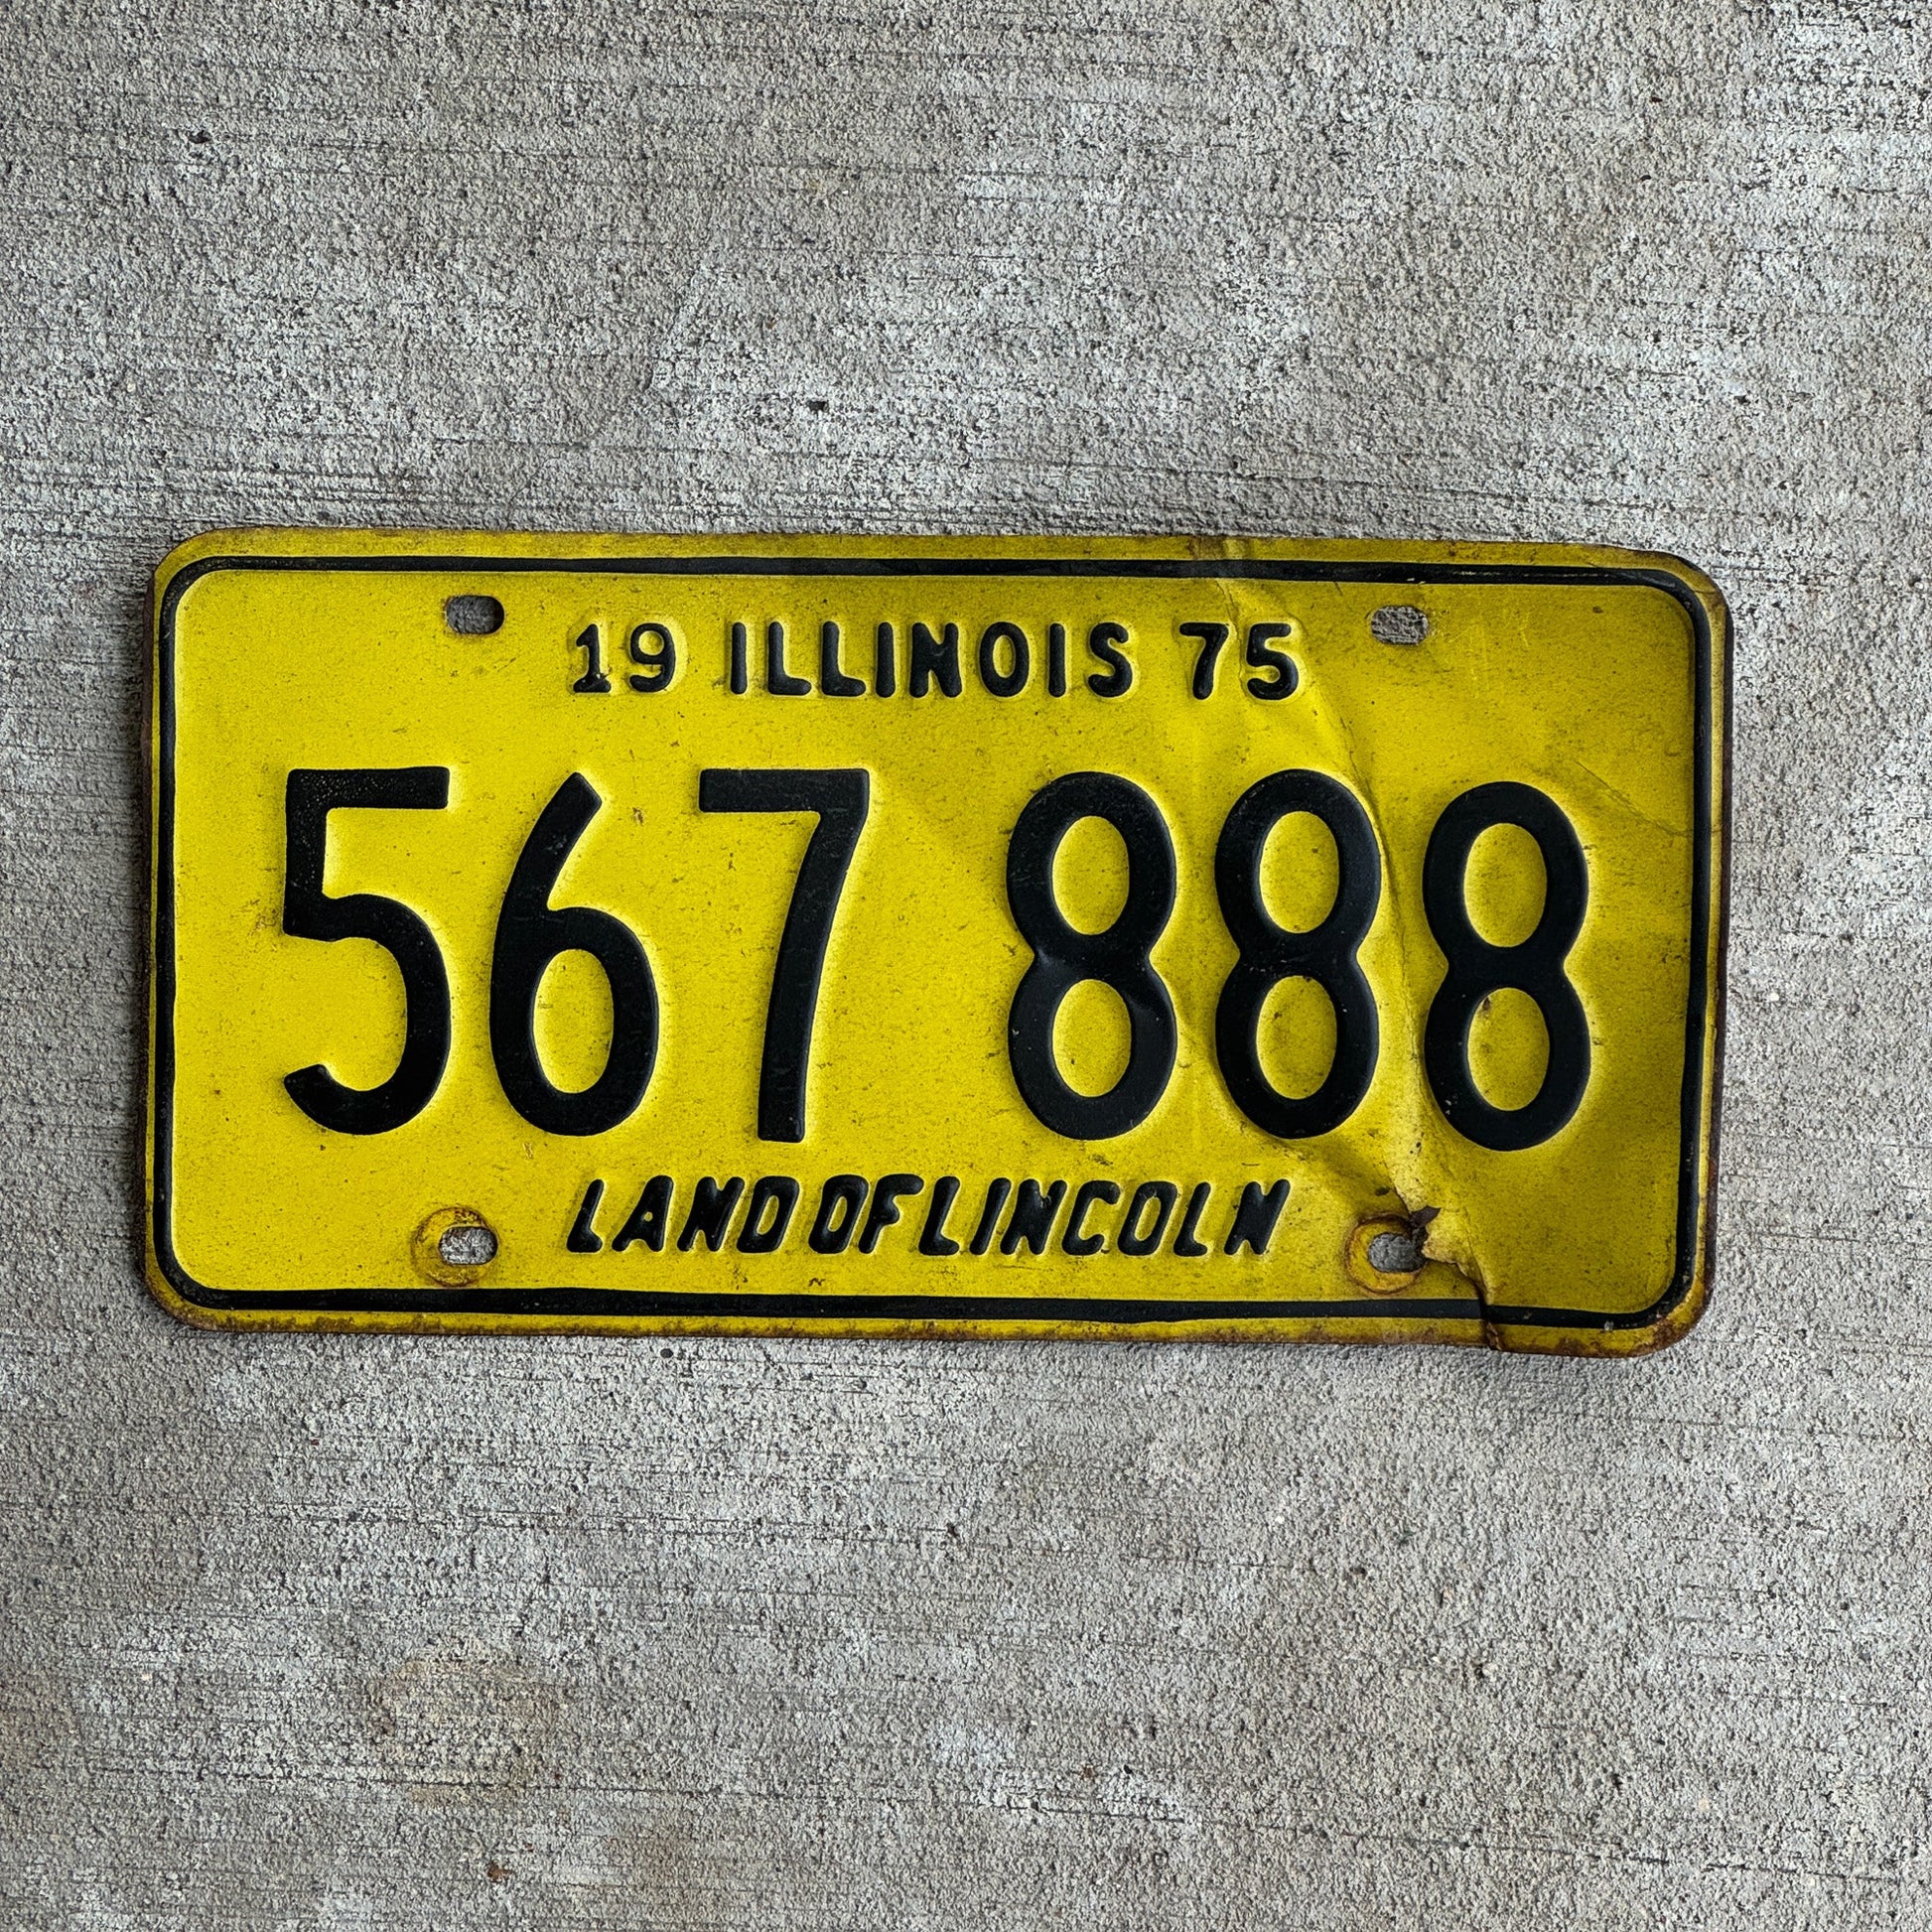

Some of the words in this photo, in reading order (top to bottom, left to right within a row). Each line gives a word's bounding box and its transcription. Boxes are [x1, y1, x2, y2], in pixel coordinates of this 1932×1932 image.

[571, 621, 677, 694] 19
[728, 621, 1135, 699] ILLINOIS
[1177, 621, 1300, 701] 75
[281, 766, 871, 1144] 567
[1005, 768, 1592, 1153] 888
[565, 1174, 801, 1255] LAND
[806, 1173, 925, 1256] OF
[916, 1175, 1292, 1258] LINCOLN
